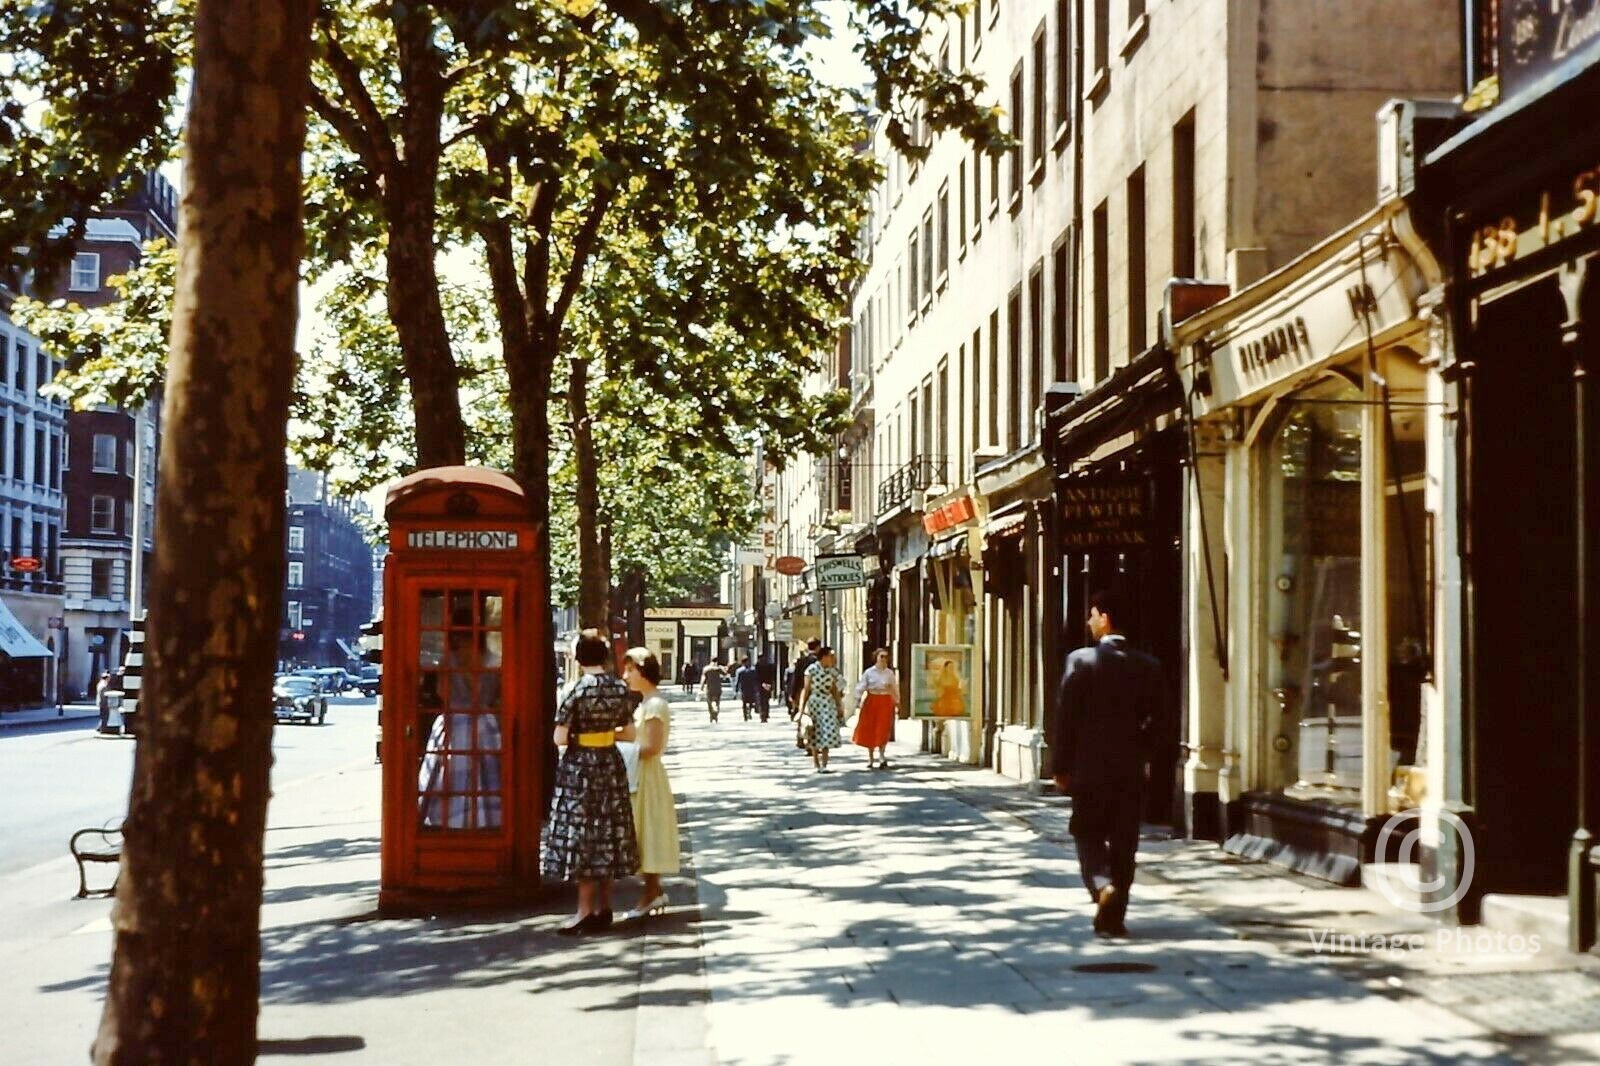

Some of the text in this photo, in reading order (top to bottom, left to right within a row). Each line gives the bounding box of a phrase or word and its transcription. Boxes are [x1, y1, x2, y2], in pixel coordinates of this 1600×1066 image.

[1064, 503, 1142, 517] PEWTER
[409, 531, 517, 548] TELEPHONE
[821, 572, 861, 583] ANTIQUES
